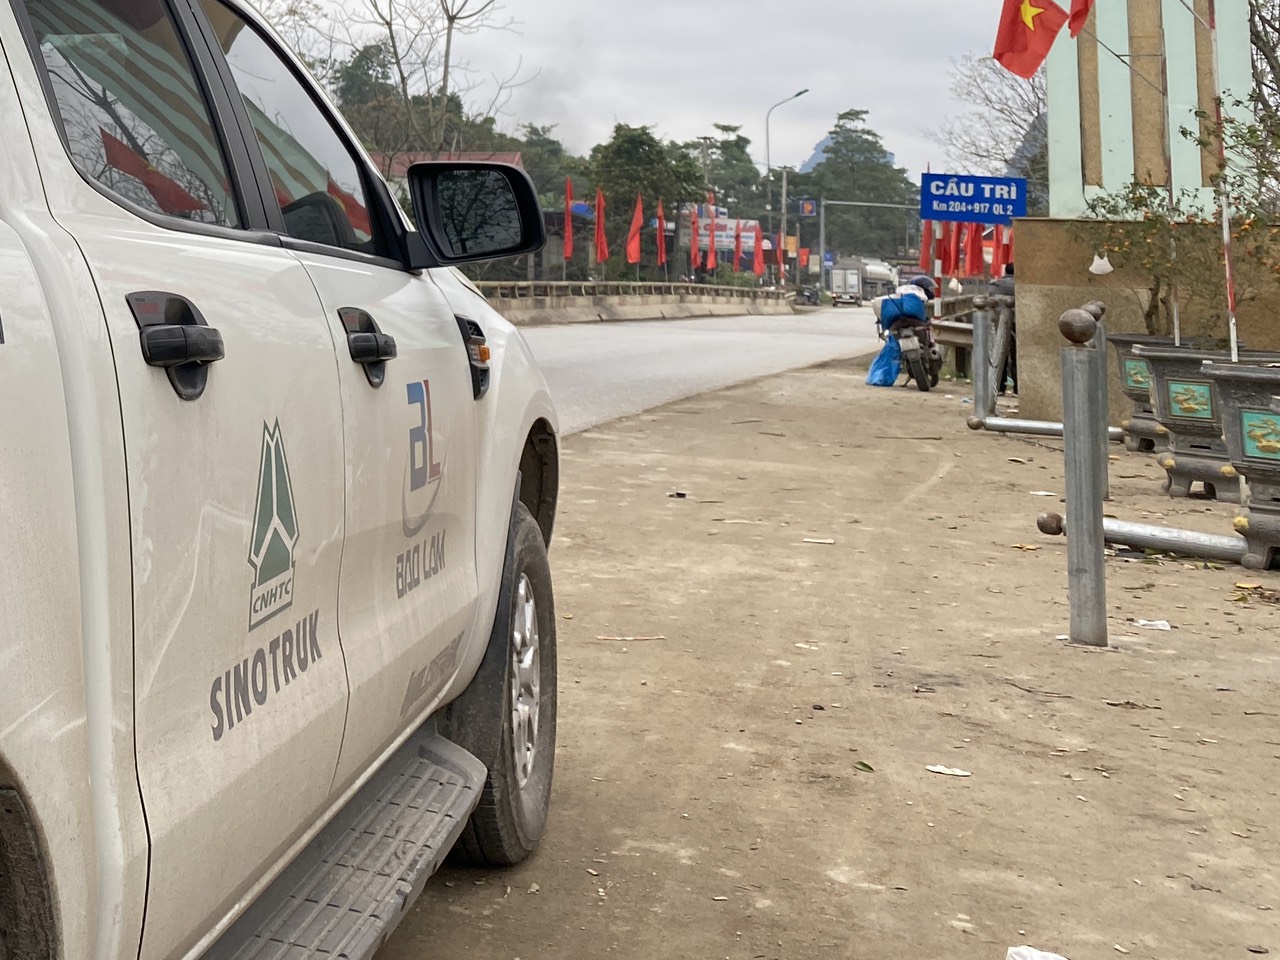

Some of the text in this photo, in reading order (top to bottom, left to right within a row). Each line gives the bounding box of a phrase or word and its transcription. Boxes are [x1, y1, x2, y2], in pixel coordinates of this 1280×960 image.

[933, 200, 1013, 216] Km 204+917 QL 2
[253, 577, 292, 614] CNHTC
[210, 608, 323, 742] SINOTRUK
